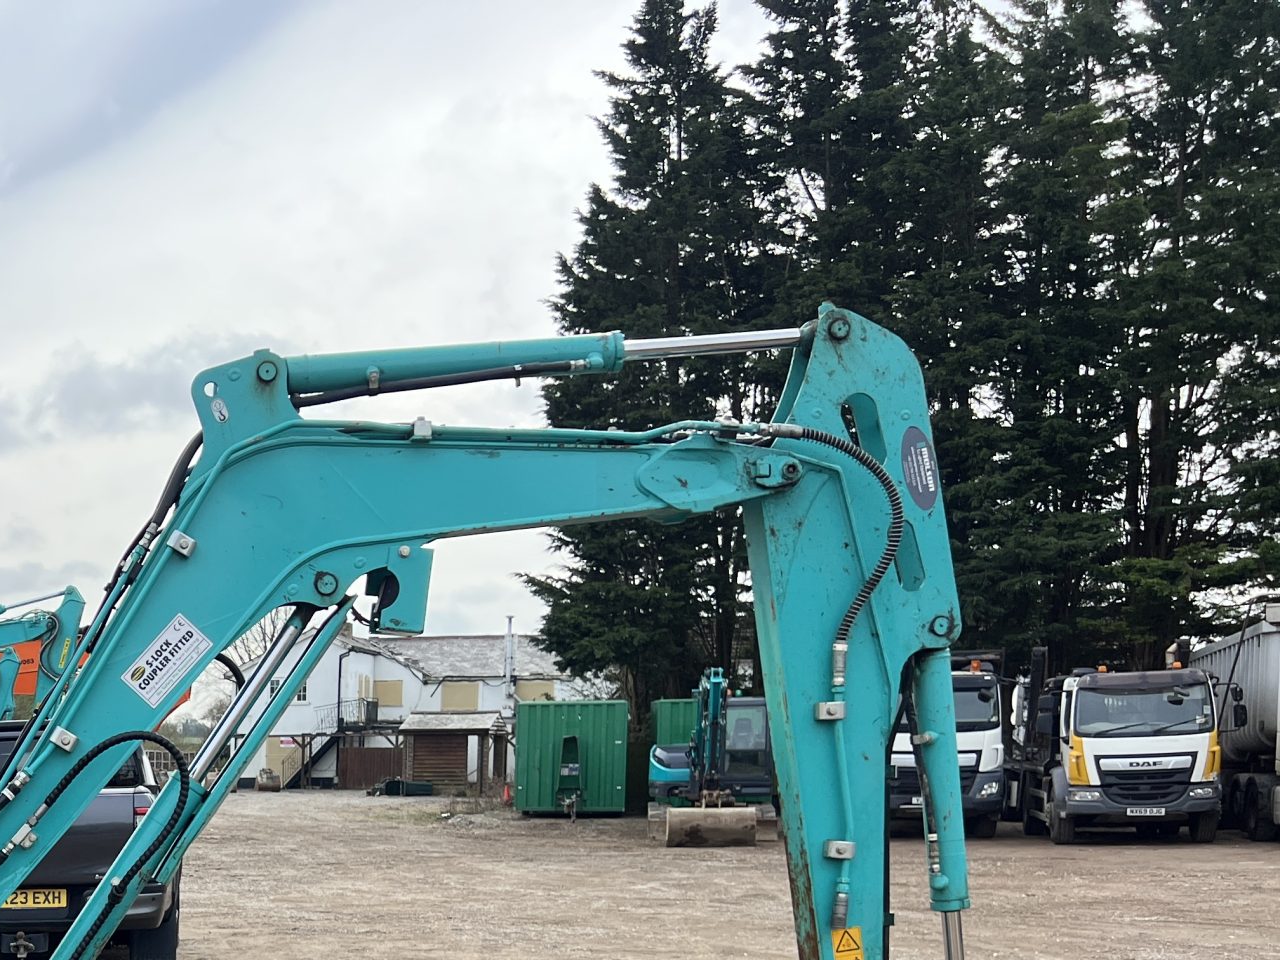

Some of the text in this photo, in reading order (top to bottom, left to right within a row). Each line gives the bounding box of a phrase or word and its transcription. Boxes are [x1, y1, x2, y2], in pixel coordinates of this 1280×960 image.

[138, 630, 194, 690] COUPLER FITTED
[146, 639, 173, 668] S-LOCK
[33, 891, 61, 904] EXH
